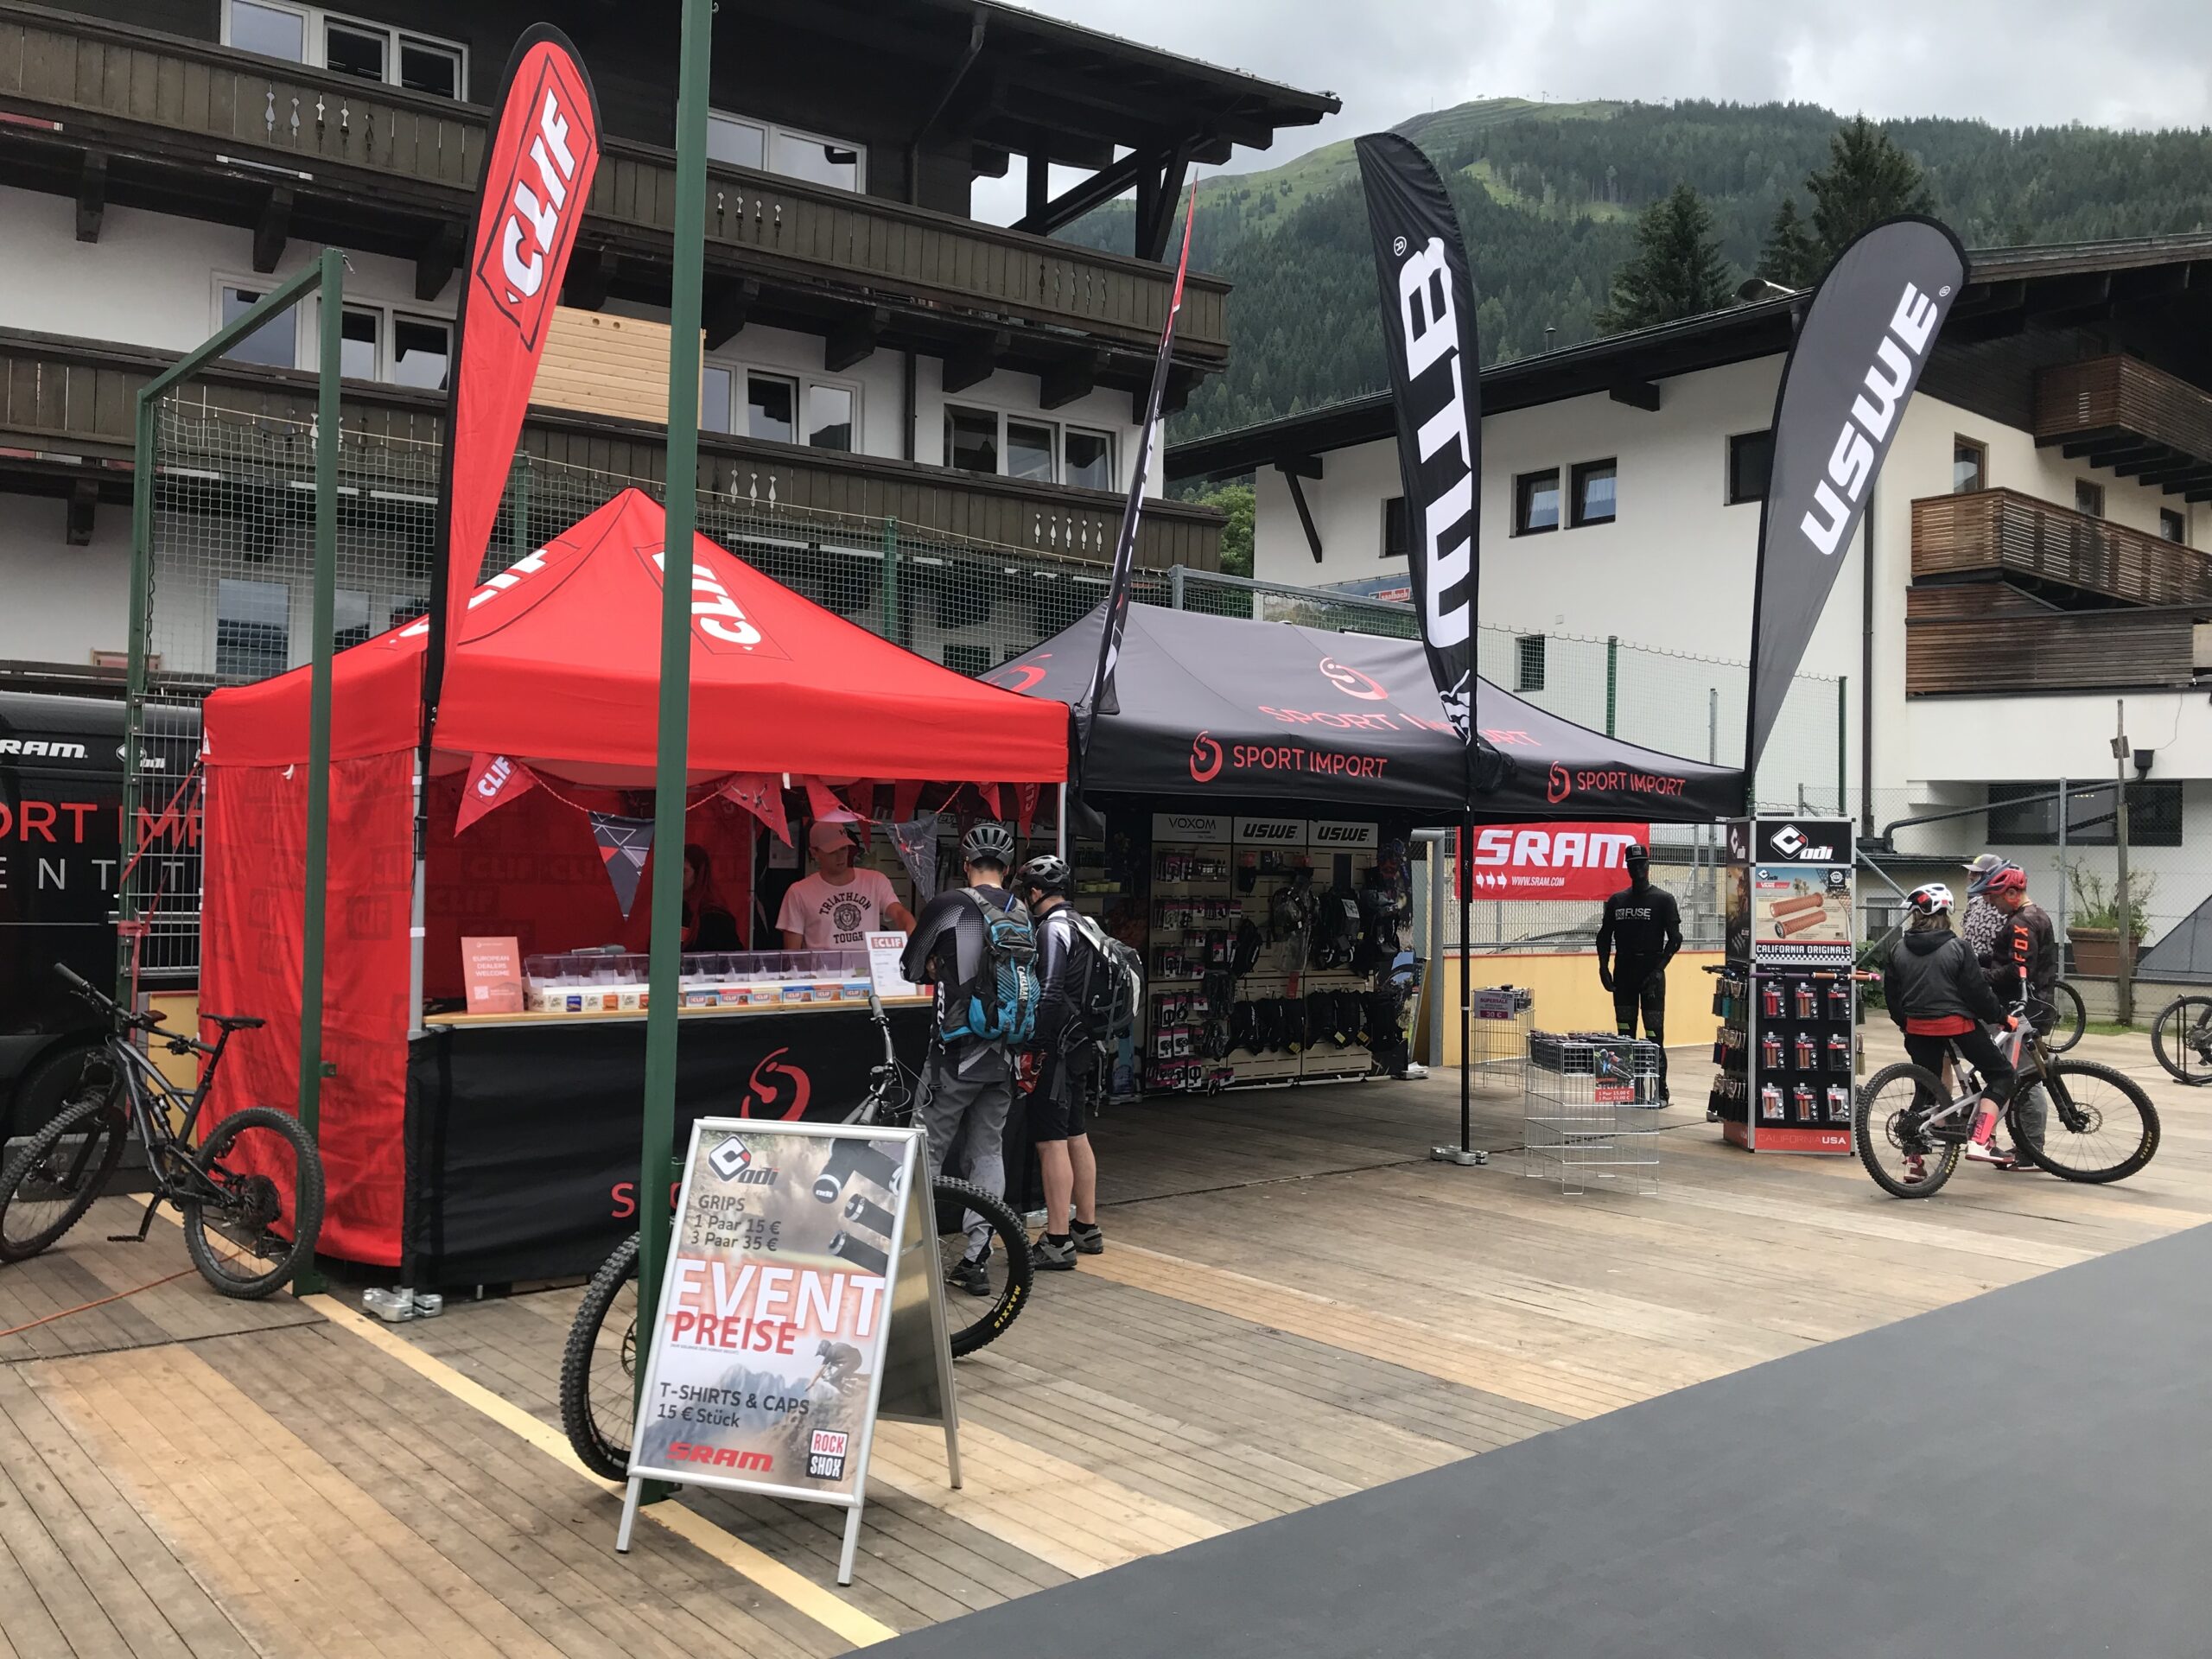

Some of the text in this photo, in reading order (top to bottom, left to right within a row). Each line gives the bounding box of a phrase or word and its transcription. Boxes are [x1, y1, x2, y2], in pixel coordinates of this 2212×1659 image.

[502, 87, 577, 304] CLIF
[1800, 282, 1938, 555] USWE
[1257, 705, 1401, 730] SPORT
[0, 739, 86, 759] RAM
[1233, 746, 1388, 779] SPORT IMPORT
[478, 756, 511, 797] CLIF
[1577, 772, 1686, 796] SPORT IMPORT
[1025, 783, 1034, 812] CLI
[1168, 817, 1216, 830] VOXOM
[1243, 823, 1297, 839] USWE
[1317, 826, 1369, 842] USWE
[1474, 830, 1637, 868] SRAM
[1800, 846, 1834, 860] odi
[1511, 876, 1565, 887] WWW.SRAM.COM
[819, 892, 872, 915] TRIATHLON
[1625, 908, 1651, 917] FUSE
[833, 931, 864, 944] TOUGH
[877, 938, 902, 948] CLIF
[2014, 925, 2029, 963] FOX
[1756, 944, 1851, 955] CALIFORNIA ORIGINALS
[1758, 1134, 1821, 1144] CALIFORNIA
[1821, 1136, 1847, 1145] USA
[738, 1167, 779, 1185] odi
[698, 1194, 746, 1211] GRIPS
[695, 1214, 781, 1235] 1 Paar 15 €
[691, 1230, 779, 1251] 3 Paar 35 €
[666, 1258, 886, 1337] EVENT
[994, 1284, 1021, 1329] MAXXIS
[671, 1311, 798, 1355] PREISE
[660, 1382, 810, 1415] T-SHIRTS & CAPS
[658, 1403, 740, 1427] 15 € Stück
[813, 1433, 845, 1454] ROCK
[665, 1441, 773, 1472] SRAM
[810, 1455, 841, 1478] SHOX
